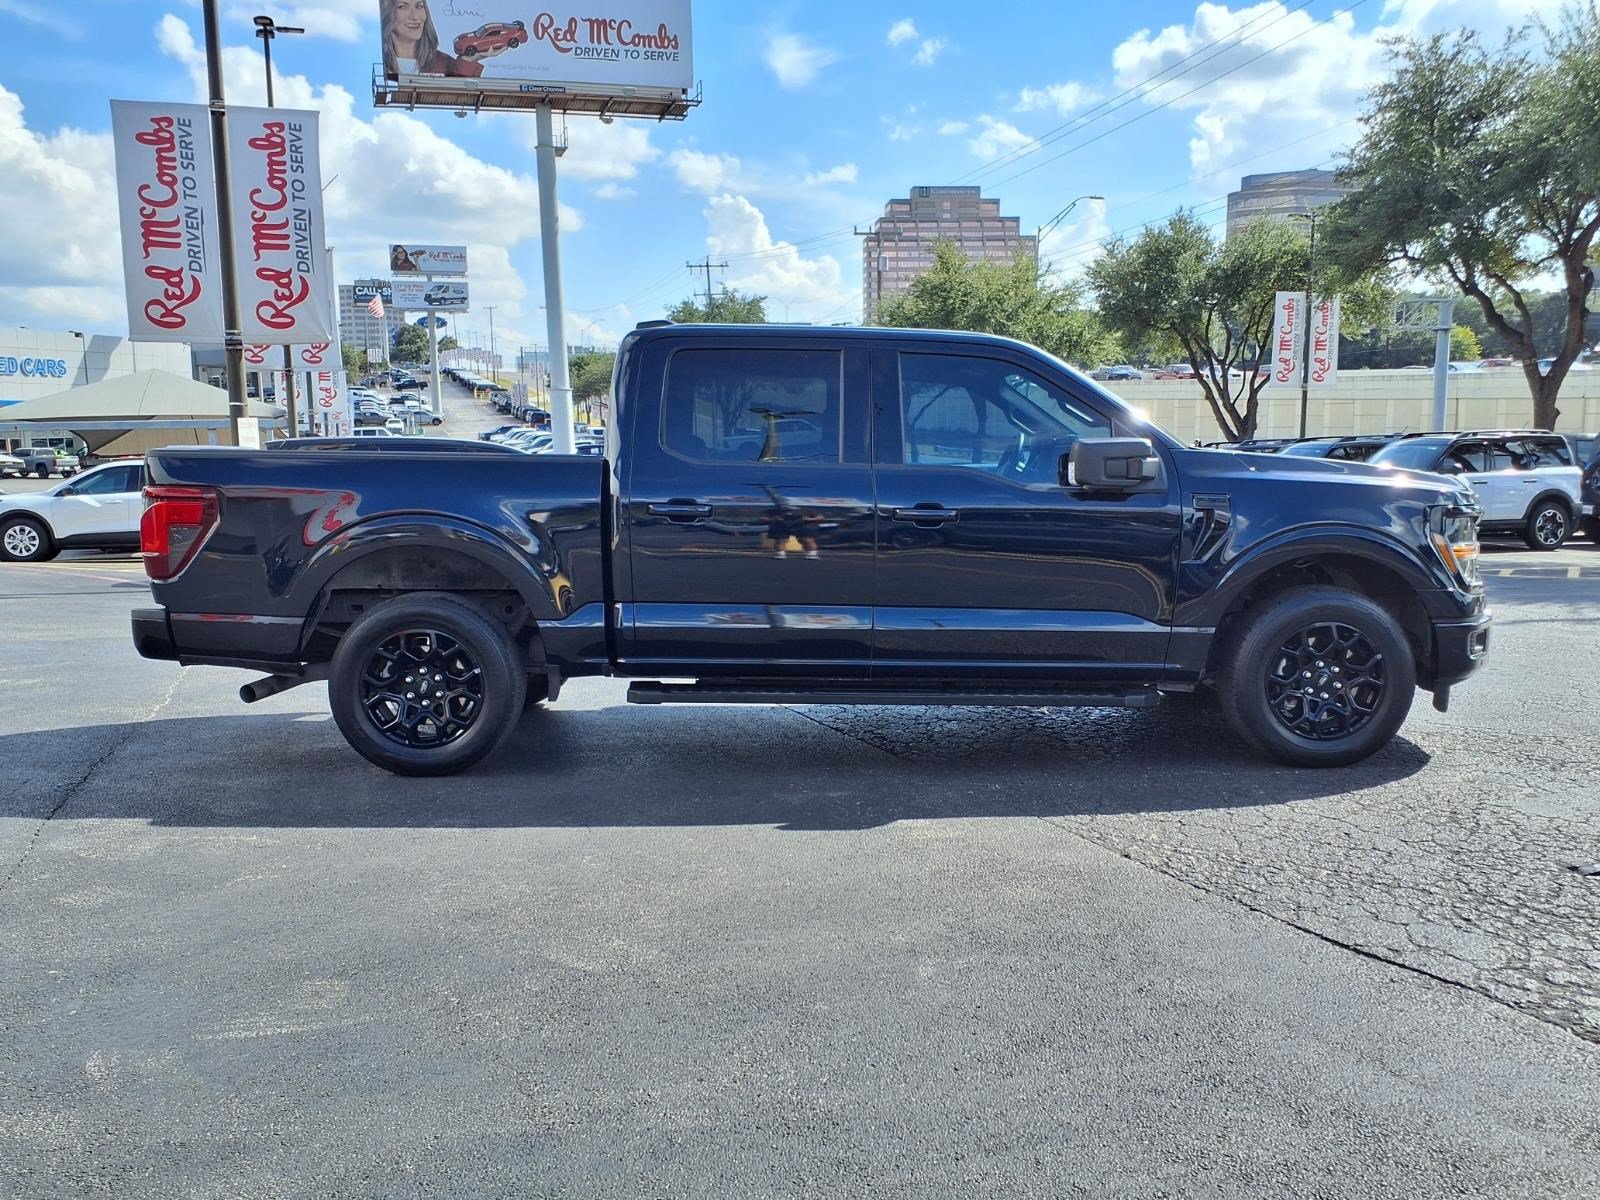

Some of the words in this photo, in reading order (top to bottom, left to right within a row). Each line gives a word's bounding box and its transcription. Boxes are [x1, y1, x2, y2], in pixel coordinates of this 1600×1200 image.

[533, 12, 577, 54] Red
[581, 16, 679, 50] McCombs
[574, 46, 621, 59] DRIVEN
[624, 50, 640, 60] TO
[643, 51, 680, 62] SERVE
[177, 117, 195, 172] SERVE
[288, 122, 305, 174] SERVE
[135, 116, 182, 260] McCombs
[182, 177, 197, 200] TO
[248, 121, 291, 262] McCombs
[292, 178, 306, 201] TO
[185, 206, 203, 273] DRIVEN
[293, 208, 311, 274] DRIVEN
[144, 265, 202, 329] Red
[255, 267, 310, 330] Red
[1278, 298, 1295, 356] McCombs
[1294, 321, 1300, 332] TO
[1313, 299, 1329, 355] McComb
[21, 358, 67, 376] CARS
[1275, 357, 1296, 383] Red
[1311, 357, 1331, 383] Red
